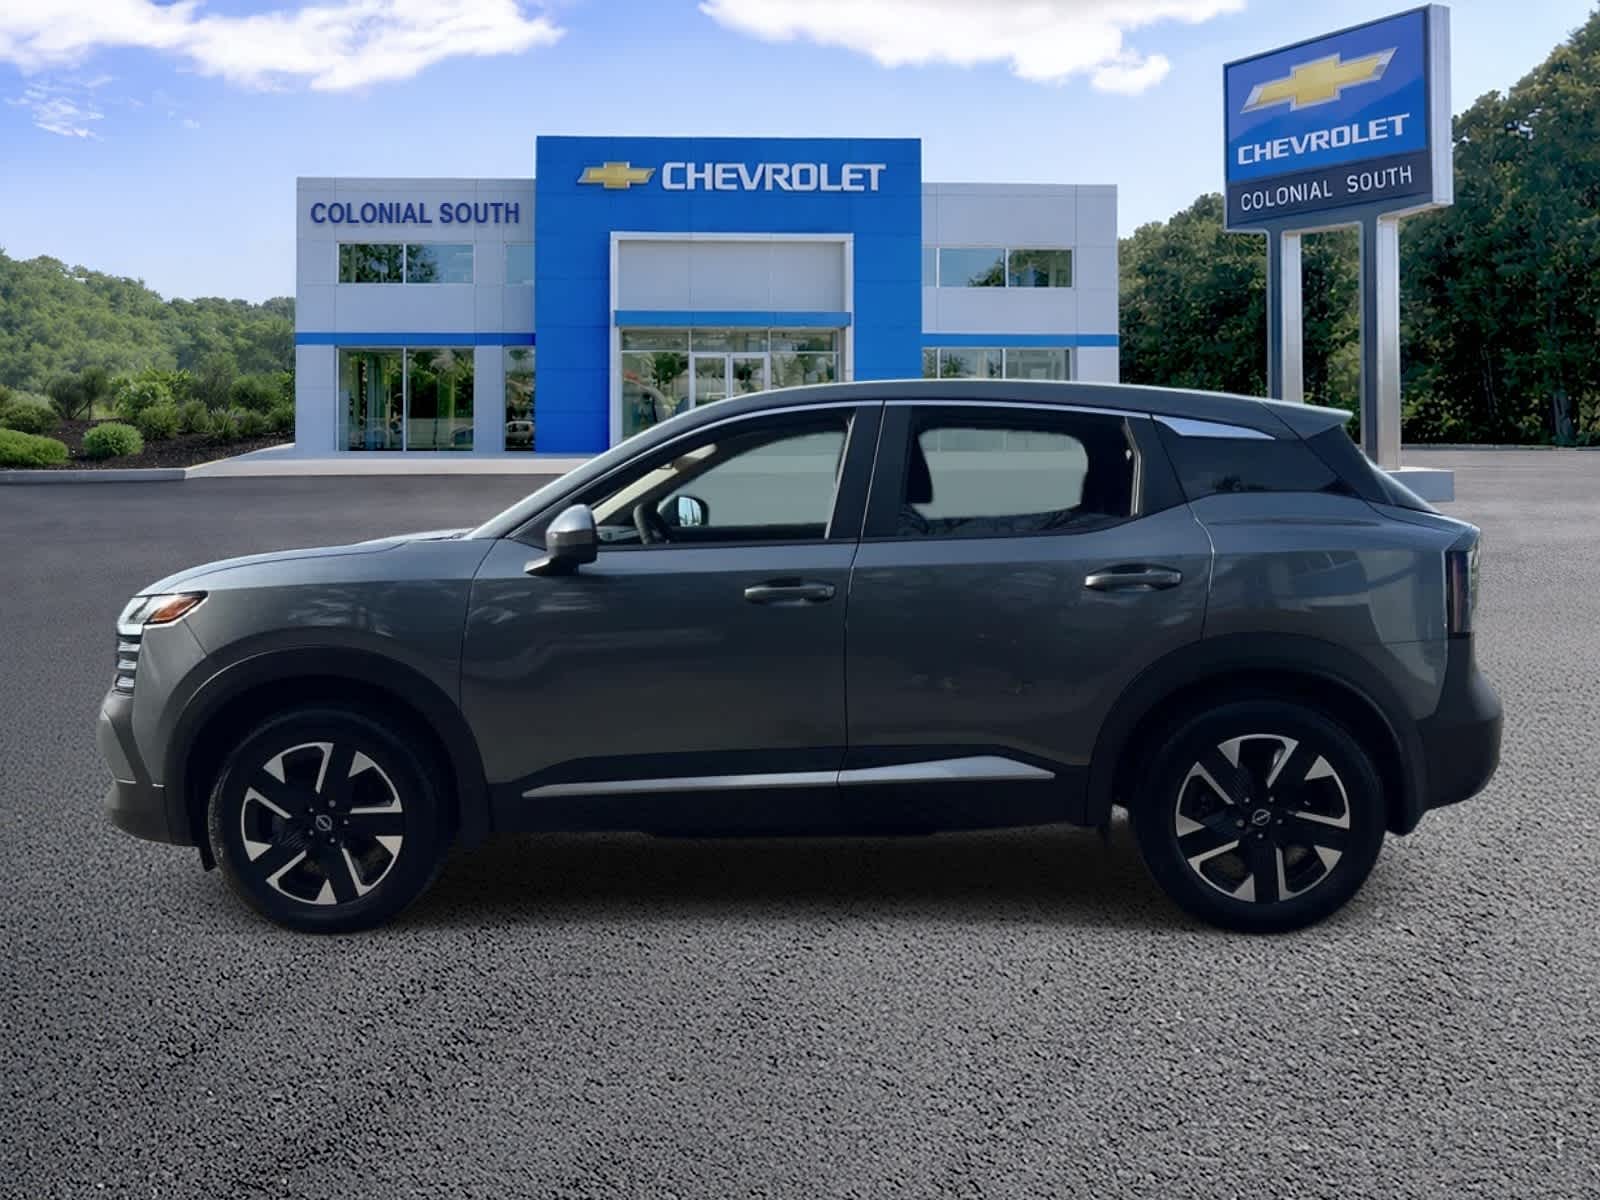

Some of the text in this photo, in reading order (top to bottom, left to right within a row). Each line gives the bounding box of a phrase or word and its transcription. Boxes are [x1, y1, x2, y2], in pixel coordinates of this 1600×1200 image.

[1238, 113, 1410, 165] CHEVROLET
[661, 162, 886, 193] CHEVROLET
[1241, 165, 1412, 211] COLONIAL SOUTH
[310, 202, 521, 225] COLONIAL SOUTH
